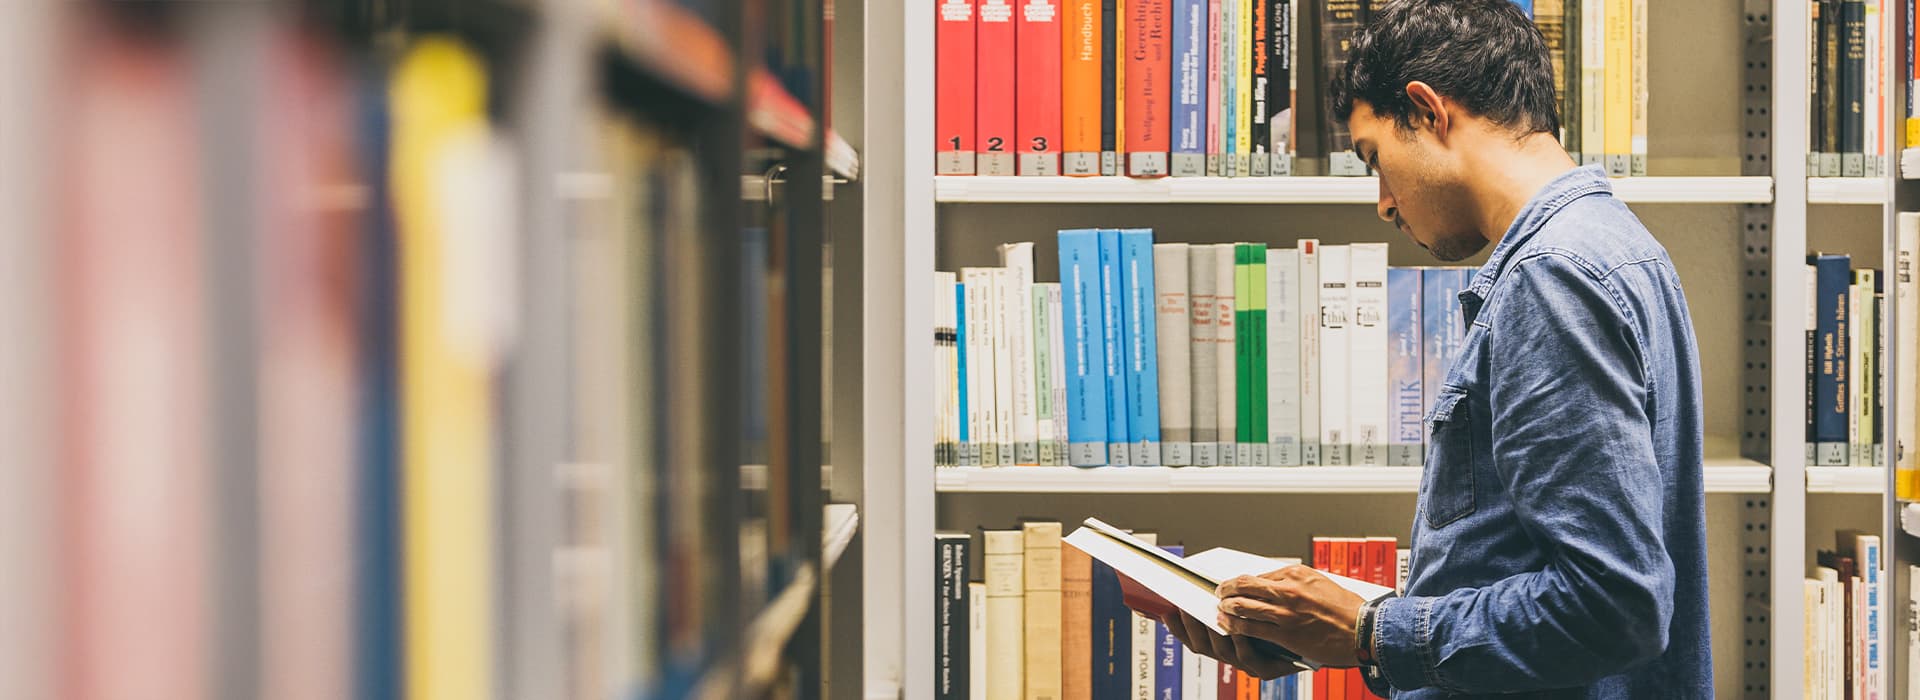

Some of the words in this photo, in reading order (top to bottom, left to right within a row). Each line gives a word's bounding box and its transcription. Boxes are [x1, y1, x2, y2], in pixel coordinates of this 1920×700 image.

[1080, 3, 1093, 61] Handbuch
[1255, 42, 1267, 75] Projekt
[1142, 67, 1153, 96] Huber
[1142, 99, 1153, 142] Wolfgang
[950, 136, 961, 151] 1
[987, 137, 1004, 151] 2
[1031, 137, 1048, 151] 3
[1321, 305, 1348, 327] Ethik
[1357, 307, 1380, 325] Ethik
[1835, 293, 1845, 320] hören
[1824, 333, 1834, 360] Hybels
[1835, 322, 1845, 357] Stimme
[1824, 361, 1833, 375] Bill
[1835, 360, 1845, 381] leise
[1835, 383, 1845, 413] Gottes
[1400, 380, 1420, 442] ETHIK
[942, 544, 952, 578] GRENZEN
[954, 544, 963, 567] Robert
[1139, 617, 1148, 635] SO
[1163, 634, 1174, 645] in
[1139, 651, 1148, 680] WOLF
[1162, 647, 1174, 667] Ruf
